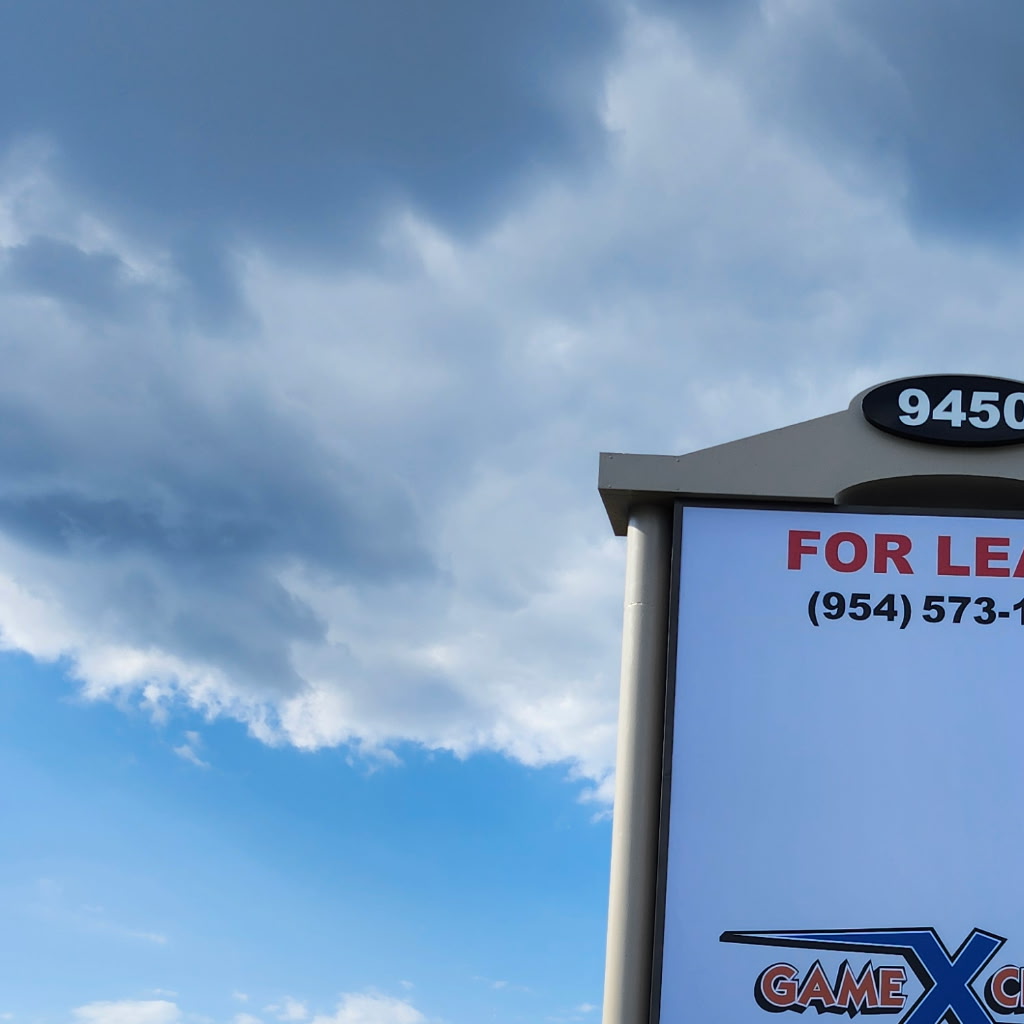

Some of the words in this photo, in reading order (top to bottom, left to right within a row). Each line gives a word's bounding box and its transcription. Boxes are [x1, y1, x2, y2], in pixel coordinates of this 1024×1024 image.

[787, 530, 913, 574] FOR
[808, 590, 912, 630] (954)
[756, 961, 908, 1017] GAME
